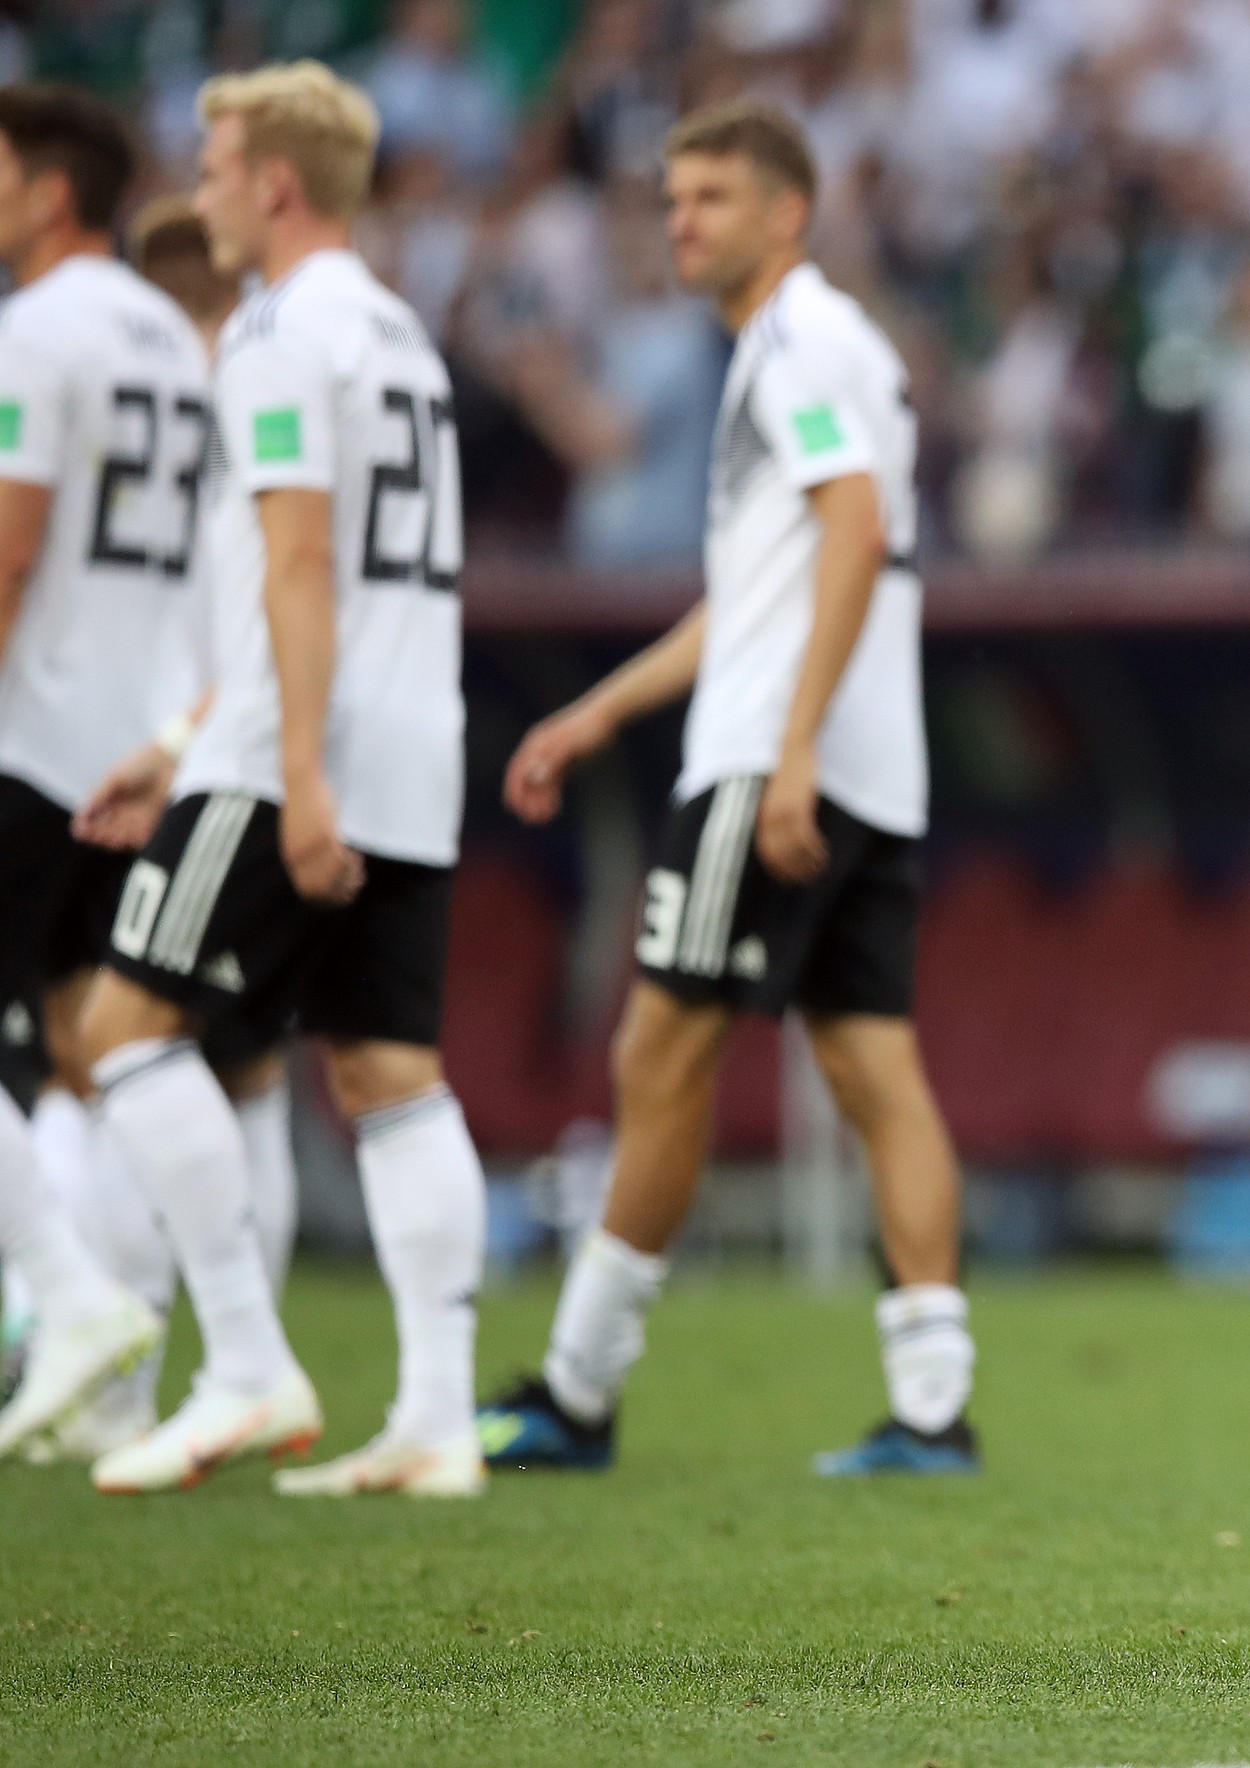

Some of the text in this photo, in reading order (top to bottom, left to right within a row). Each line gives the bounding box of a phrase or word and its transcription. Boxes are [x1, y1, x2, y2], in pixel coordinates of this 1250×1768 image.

[91, 387, 207, 577] 23
[363, 387, 458, 593] 20
[634, 867, 686, 971] 3
